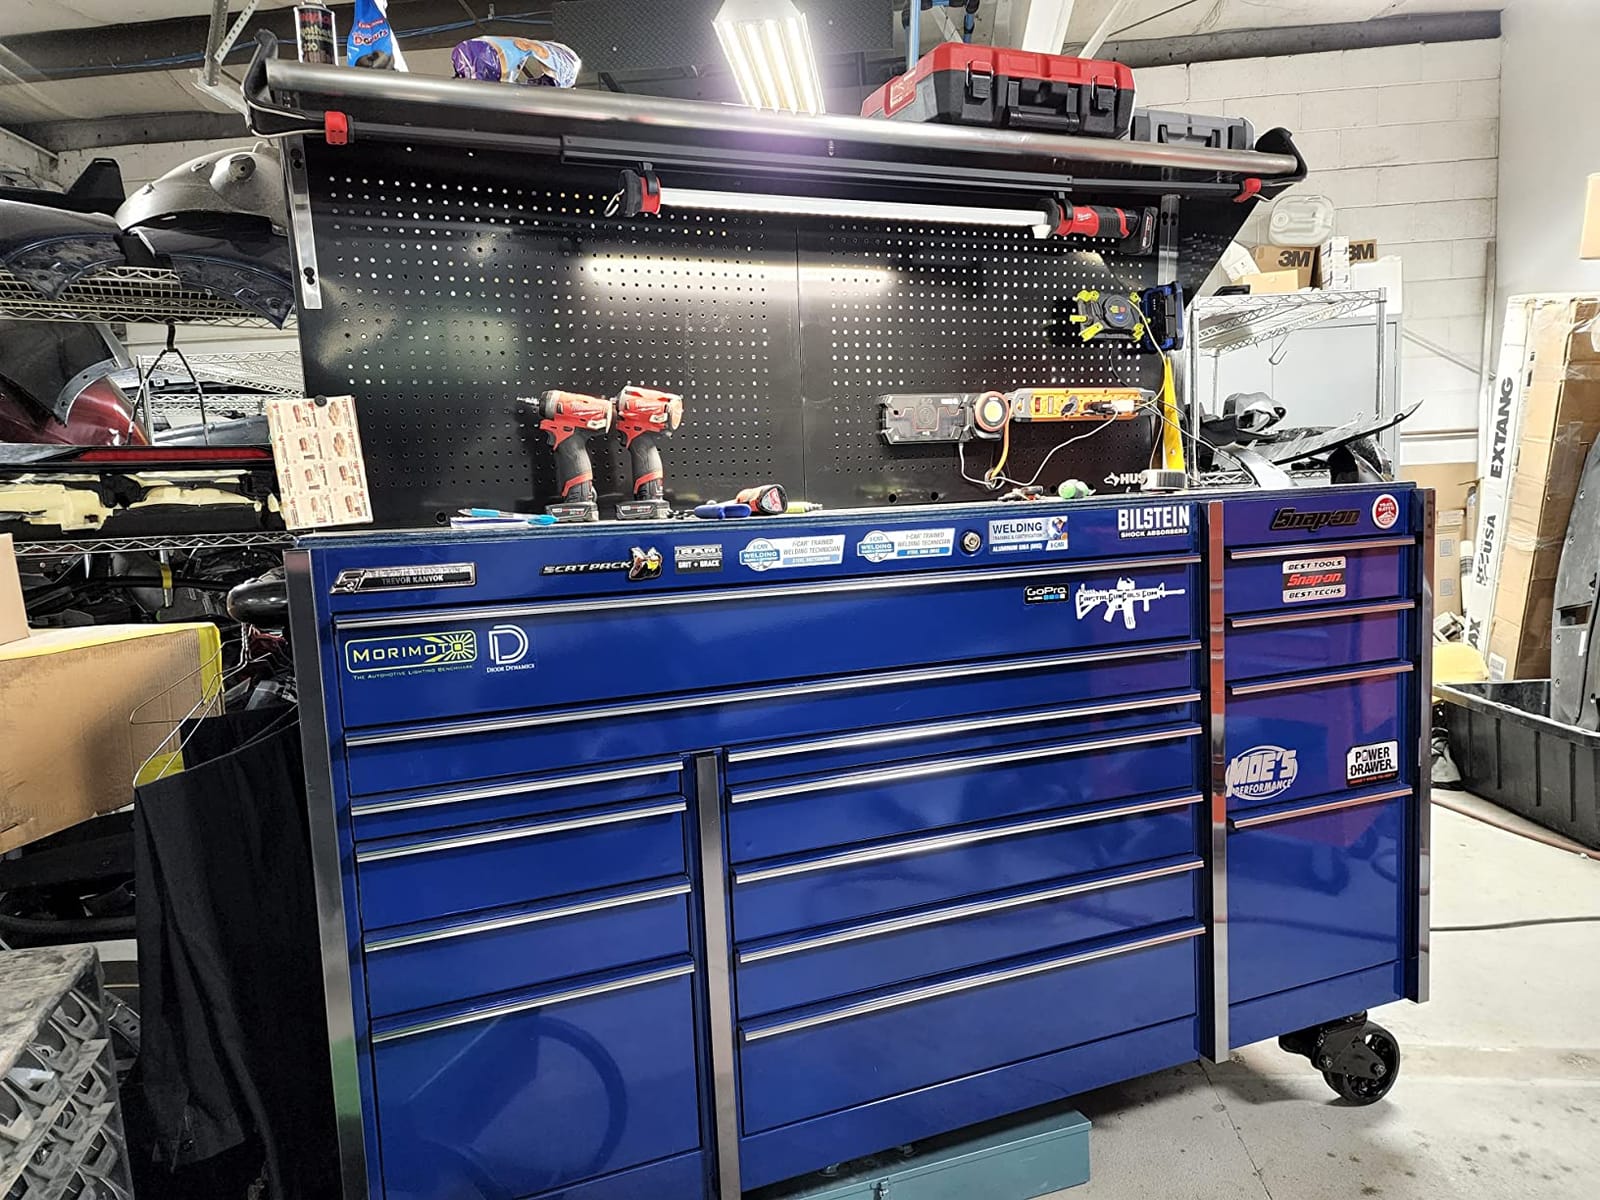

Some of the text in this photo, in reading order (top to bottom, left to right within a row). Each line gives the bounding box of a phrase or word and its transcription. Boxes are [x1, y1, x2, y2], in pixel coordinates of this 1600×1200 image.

[1278, 250, 1312, 268] 3M
[1490, 377, 1514, 479] EXTANG
[1118, 505, 1190, 531] BILSTEIN
[1271, 507, 1360, 532] Snap-on
[992, 522, 1043, 534] WELDING
[1120, 528, 1188, 538] SHOCK ABSORBERS
[1483, 515, 1496, 554] USA
[543, 561, 632, 574] SCAT PACK
[1288, 560, 1342, 571] BEST TOOLS
[382, 574, 444, 585] TREVOR KANYOK
[1287, 573, 1342, 586] Snap-on
[1027, 586, 1067, 596] GoPro
[1288, 588, 1342, 599] BEST TECHS
[1467, 617, 1481, 650] AX
[1355, 747, 1390, 764] POWER
[1226, 750, 1297, 797] MOE'S
[1350, 759, 1392, 776] DRAWER
[1232, 779, 1292, 795] PERFORMANCE
